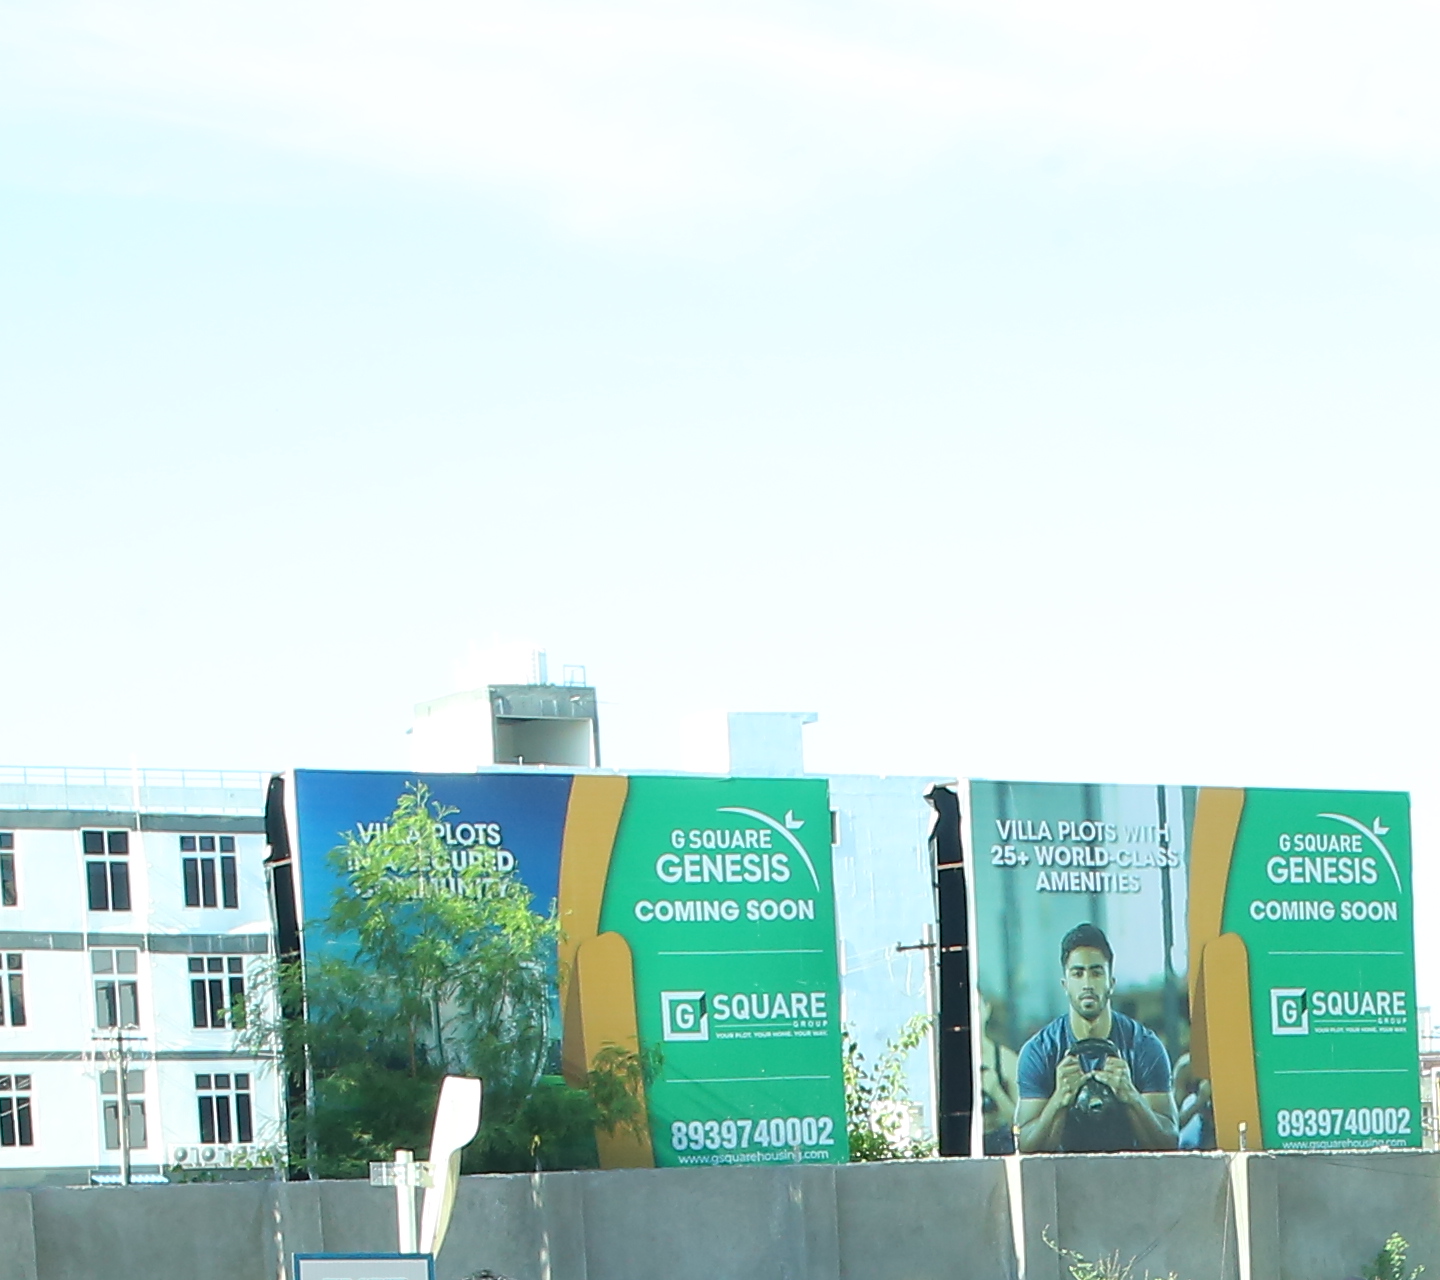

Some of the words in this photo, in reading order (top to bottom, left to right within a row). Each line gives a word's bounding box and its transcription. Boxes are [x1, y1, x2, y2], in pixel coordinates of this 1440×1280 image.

[431, 823, 502, 846] PLOTS
[671, 829, 685, 849] G
[689, 829, 772, 849] SQUARE
[996, 820, 1053, 841] VILLA
[1058, 821, 1117, 842] PLOTS
[1125, 823, 1170, 843] WITH
[1279, 834, 1291, 852] G
[1294, 834, 1363, 853] SQUARE
[656, 853, 790, 883] GENESIS
[990, 845, 1030, 866] 25+
[1034, 846, 1180, 868] WORLD-CLASS
[1036, 871, 1141, 892] AMENITIES
[1266, 856, 1378, 884] GENESIS
[634, 900, 740, 922] COMING
[746, 899, 815, 921] SOON
[1250, 900, 1335, 921] COMING
[1340, 900, 1398, 921] SOON
[675, 1003, 695, 1029] G
[713, 992, 827, 1020] SQUARE
[1282, 999, 1297, 1024] G
[1312, 991, 1407, 1016] SQUARE
[671, 1116, 834, 1151] 8939740002
[1277, 1107, 1411, 1137] 8939740002
